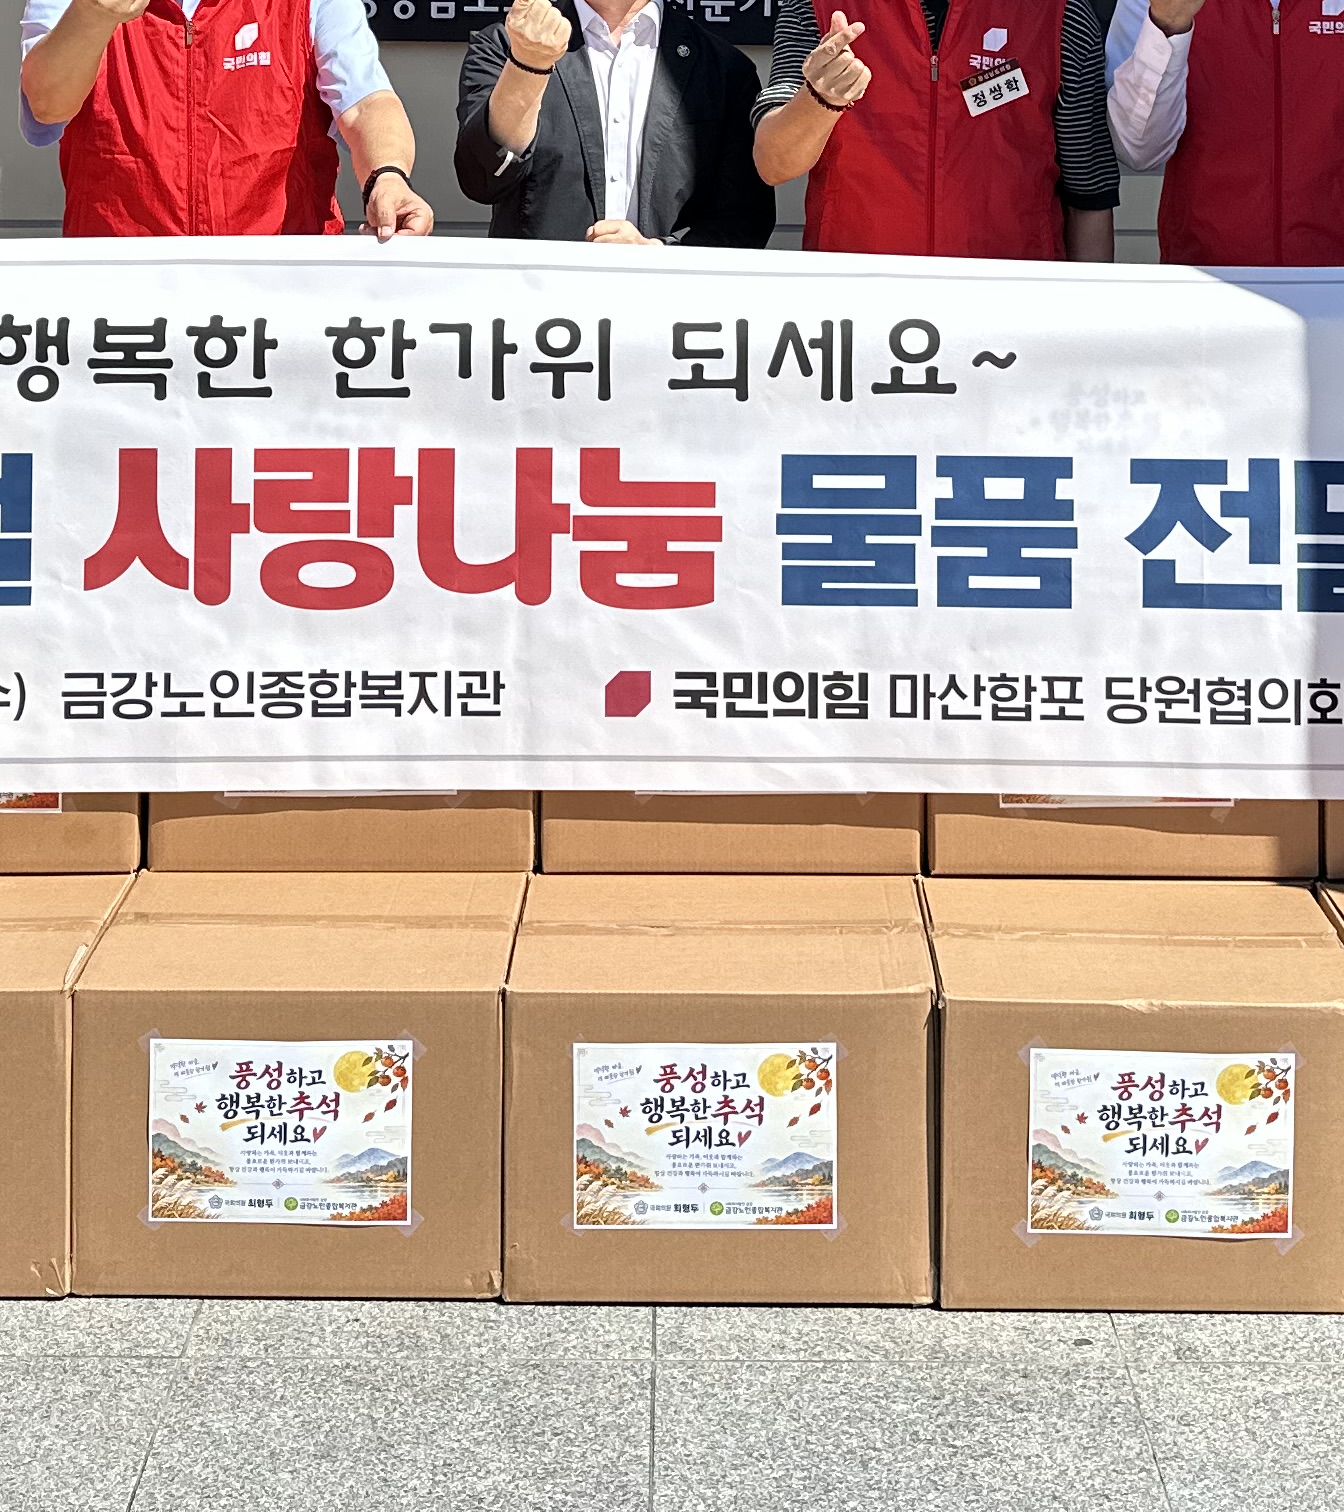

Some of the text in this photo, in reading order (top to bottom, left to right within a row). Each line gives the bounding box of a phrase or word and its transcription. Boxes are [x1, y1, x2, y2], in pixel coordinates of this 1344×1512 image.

[223, 52, 271, 71] 국민의힘
[969, 54, 1006, 70] 국민의
[325, 317, 611, 401] 한가위
[667, 318, 1018, 402] 되세요~
[83, 447, 723, 610] 사랑나눔
[775, 454, 1078, 610] 물품
[61, 669, 505, 719] 금강노인종합복지관
[672, 670, 870, 721] 국민의힘
[889, 672, 1086, 722] 마산합포
[229, 1061, 326, 1090] 풍성하고
[653, 1063, 751, 1093] 풍성하고
[1111, 1072, 1208, 1101] 풍성하고
[243, 1122, 312, 1146] 되세요
[667, 1127, 736, 1150] 되세요
[1125, 1134, 1193, 1157] 되세요
